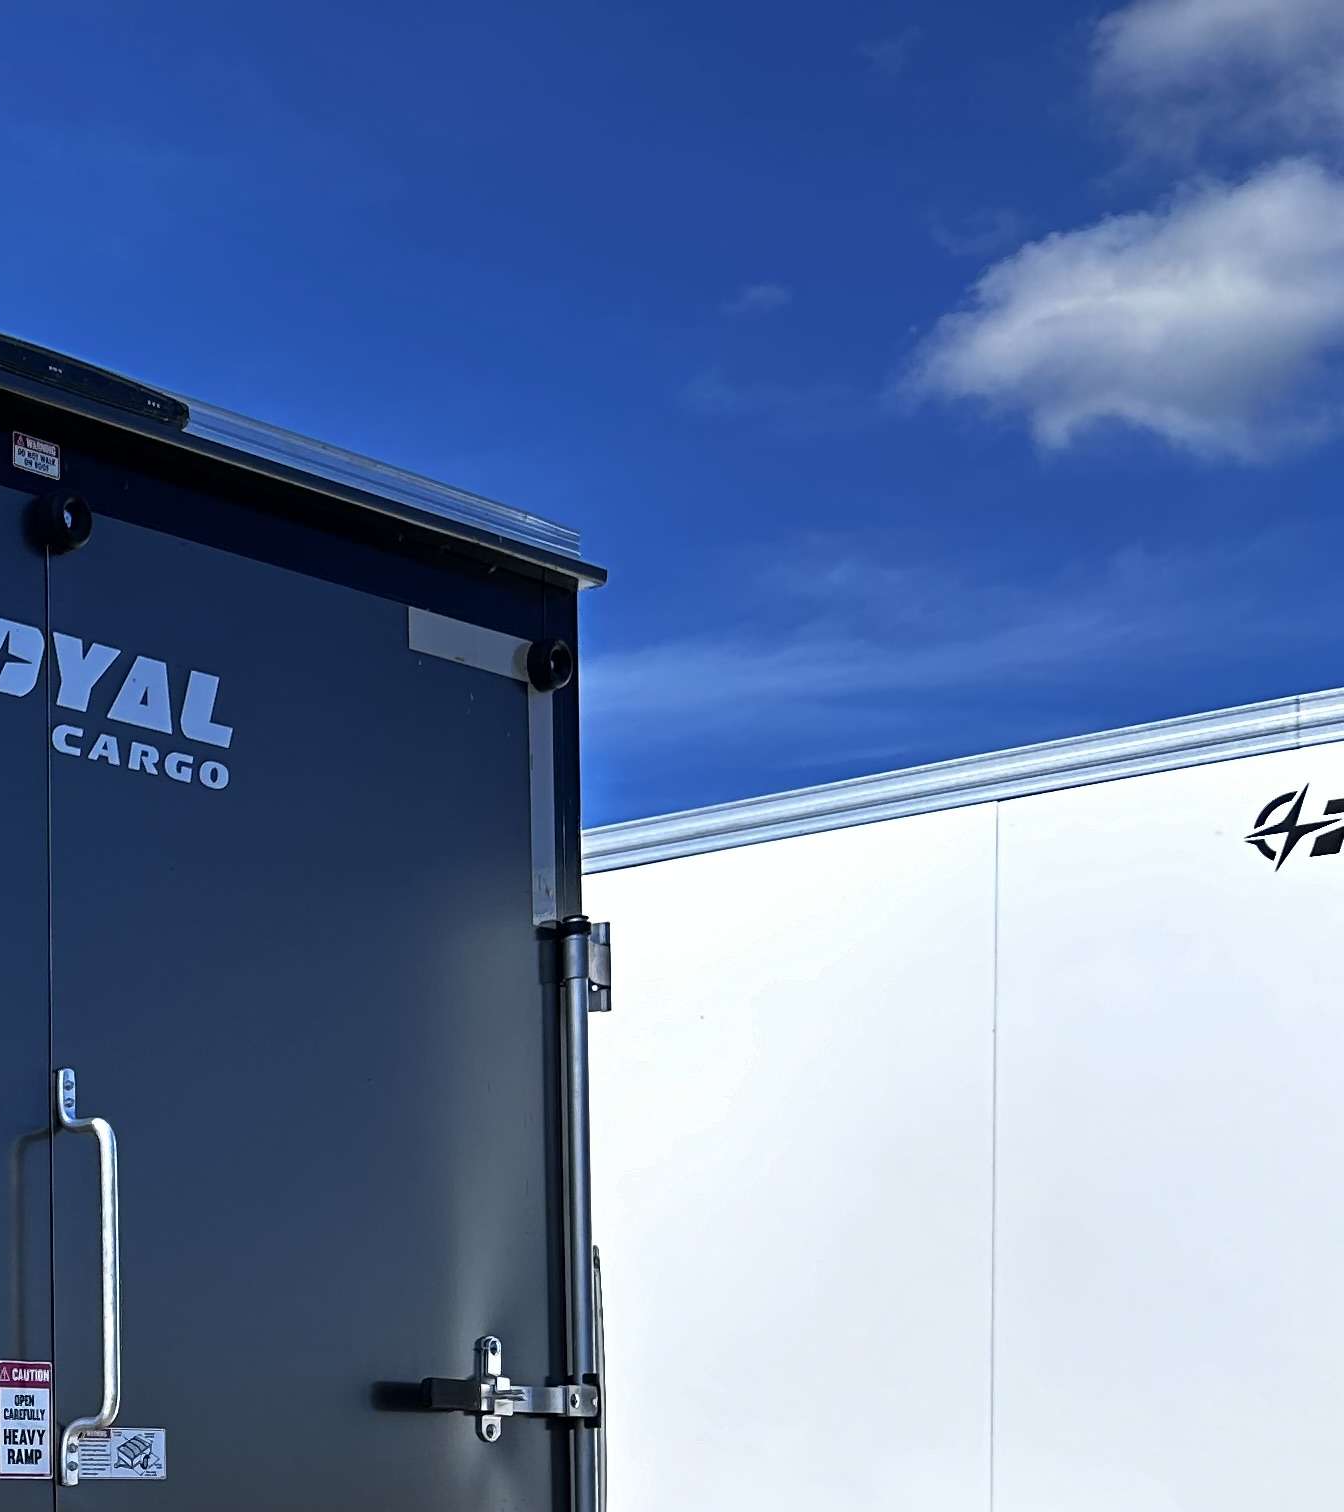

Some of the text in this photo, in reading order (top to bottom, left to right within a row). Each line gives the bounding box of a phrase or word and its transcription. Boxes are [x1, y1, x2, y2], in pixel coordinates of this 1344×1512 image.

[50, 723, 231, 790] CARGO
[11, 1367, 49, 1382] CAUTION
[14, 1394, 35, 1407] OPEN
[3, 1408, 46, 1421] CAREFULLY
[3, 1428, 46, 1446] HEAVY
[7, 1448, 42, 1465] RAMP
